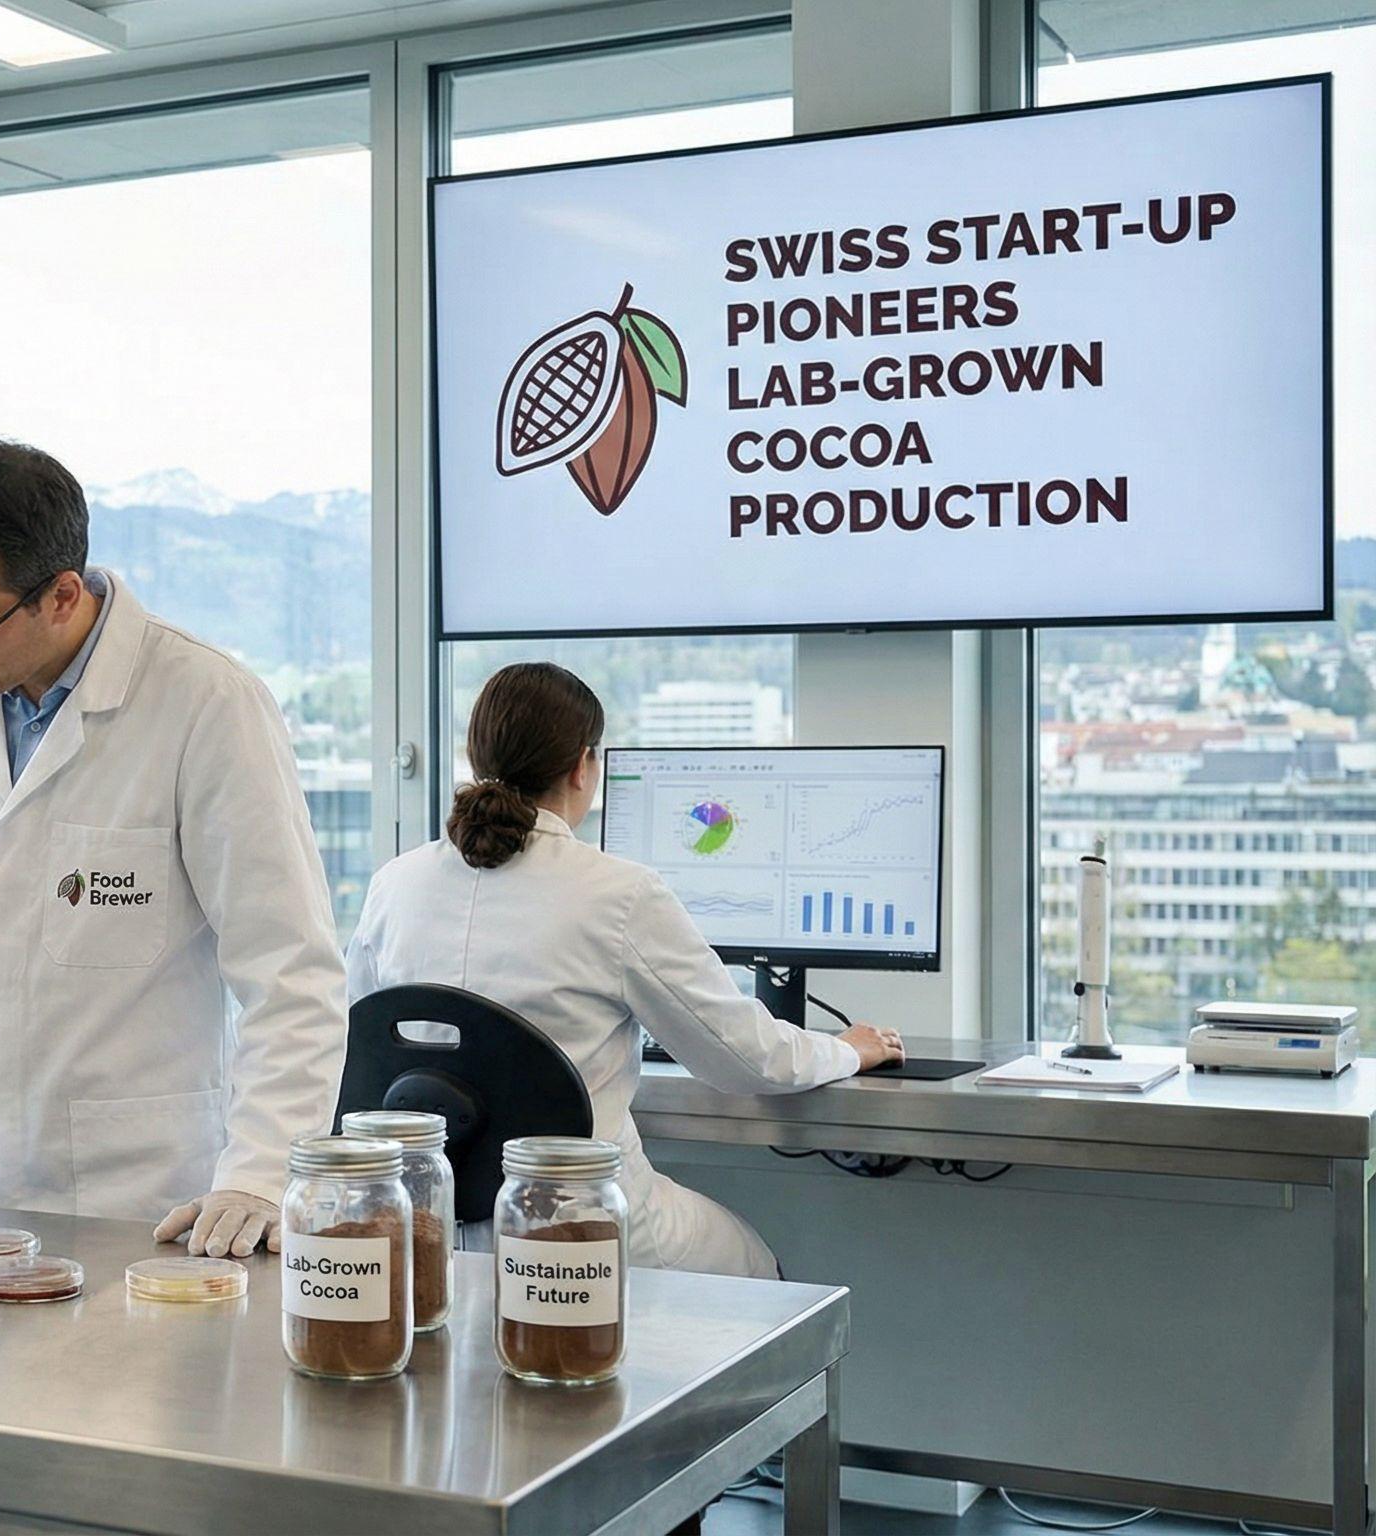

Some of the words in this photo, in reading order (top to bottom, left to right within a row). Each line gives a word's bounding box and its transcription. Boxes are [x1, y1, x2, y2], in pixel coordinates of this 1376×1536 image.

[724, 224, 910, 283] SWISS
[926, 192, 1237, 265] START-UP
[727, 280, 1019, 347] PIONEERS
[727, 341, 1103, 411] LAB-GROWN
[726, 421, 933, 474] COCOA
[729, 476, 1128, 538] PRODUCTION
[90, 871, 135, 889] Food
[90, 889, 153, 906] Brewer
[286, 1253, 381, 1276] Lab-Grown
[504, 1257, 612, 1280] Sustainable
[300, 1280, 359, 1300] Cocoa
[526, 1285, 591, 1304] Future
